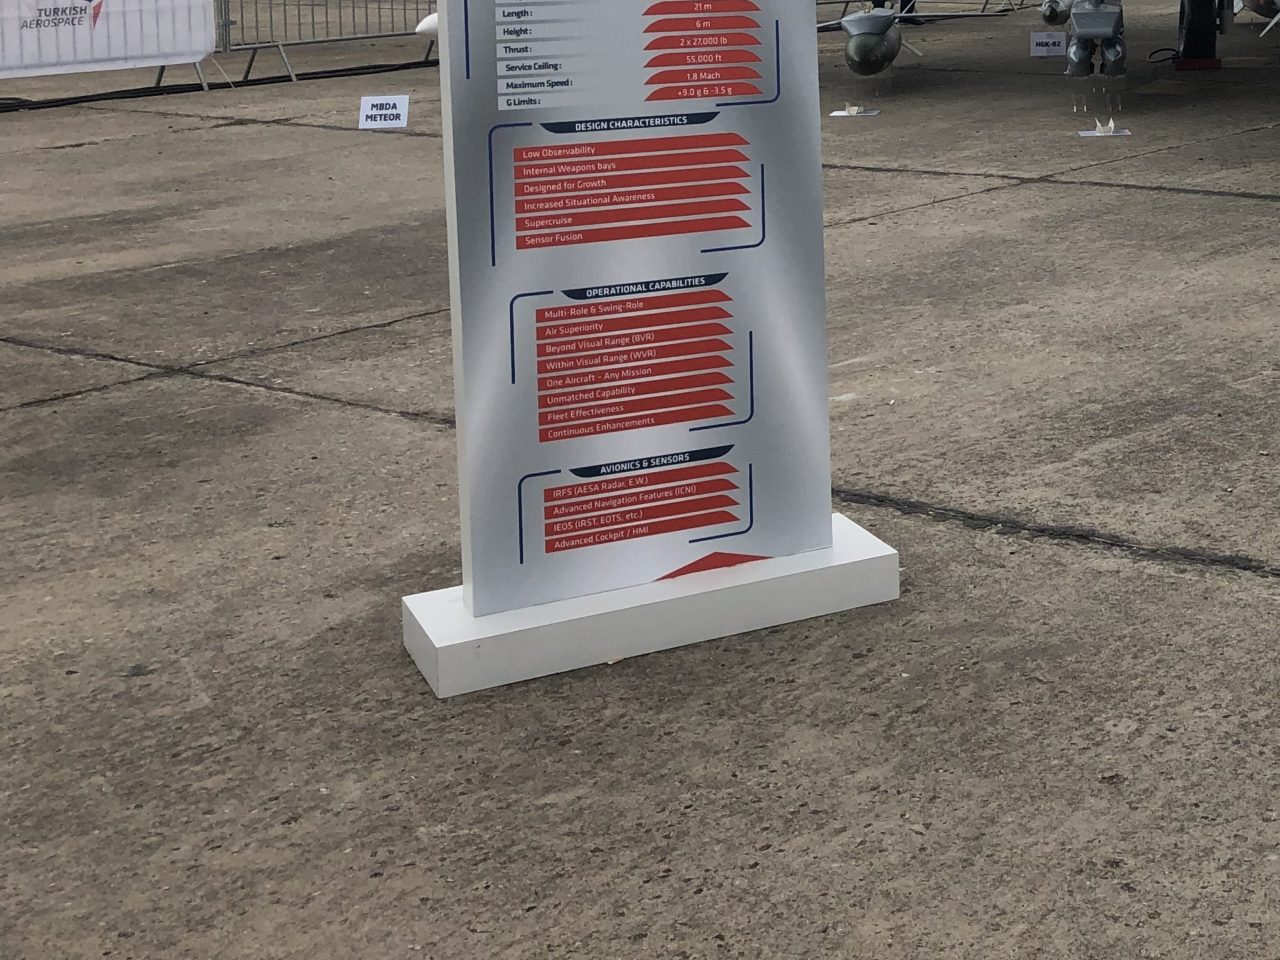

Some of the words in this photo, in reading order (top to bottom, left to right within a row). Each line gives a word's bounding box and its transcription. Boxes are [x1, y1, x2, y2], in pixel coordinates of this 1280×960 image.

[37, 6, 88, 18] TURKISH
[502, 10, 528, 18] Length
[20, 16, 84, 30] AEROSPACE
[503, 28, 528, 37] Height
[693, 38, 718, 46] 27,000
[503, 46, 528, 54] Thrust
[533, 62, 558, 71] Ceiling
[686, 55, 713, 64] 55,000
[506, 81, 545, 89] Maximum
[546, 79, 569, 88] Speed
[678, 89, 695, 97] +9.0
[371, 102, 398, 111] MBDA
[366, 113, 402, 122] METEOR
[575, 122, 607, 131] DESIGN
[609, 116, 687, 130] CHARACTERISTICS
[542, 146, 595, 157] Observability
[523, 166, 555, 176] Internal
[557, 163, 595, 174] Weapons
[598, 162, 616, 170] bays
[524, 183, 561, 193] Designed
[564, 181, 575, 189] for
[577, 179, 606, 188] Growth
[524, 200, 563, 210] Increased
[566, 196, 609, 207] Situational
[613, 193, 655, 202] Awareness
[525, 217, 572, 228] Supercruise
[526, 236, 553, 245] Sensor
[555, 233, 583, 242] Fusion
[586, 284, 647, 297] OPERATIONAL
[649, 277, 705, 291] CAPABILITIES
[545, 307, 588, 318] Multi-Role
[591, 306, 596, 314] &
[599, 301, 643, 313] Swing-Role
[546, 327, 557, 335] Air
[560, 323, 603, 335] Superiority
[546, 343, 576, 353] Beyond
[578, 339, 602, 349] Visual
[605, 336, 630, 346] Range
[632, 333, 655, 343] (BVR)
[546, 360, 574, 370] Within
[576, 356, 600, 366] Visual
[603, 353, 628, 363] Range
[630, 349, 656, 360] (WVR)
[547, 379, 562, 387] One
[565, 374, 595, 385] Aircraft
[604, 371, 620, 381] Any
[622, 367, 651, 377] Mission
[547, 391, 594, 404] Unmatched
[596, 386, 635, 398] Capability
[548, 412, 568, 421] Fleet
[570, 405, 624, 418] Effectiveness
[548, 425, 594, 438] Continuous
[596, 417, 655, 432] Enhancements
[600, 461, 640, 474] AVIONICS
[642, 460, 649, 468] &
[650, 453, 690, 466] SENSORS
[553, 488, 572, 498] IRFS
[574, 483, 599, 495] (AESA
[602, 478, 625, 489] Radar,
[554, 502, 592, 515] Advanced
[594, 494, 637, 508] Navigation
[640, 489, 673, 500] Features
[675, 484, 696, 496] (ICNI)
[554, 522, 573, 532] IEOS
[575, 517, 598, 529] (IRST,
[600, 515, 623, 524] EOTS,
[626, 510, 642, 519] etc.)
[554, 536, 593, 548] Advanced
[595, 530, 624, 542] Cockpit
[626, 528, 630, 537] /
[632, 526, 648, 535] HMI
